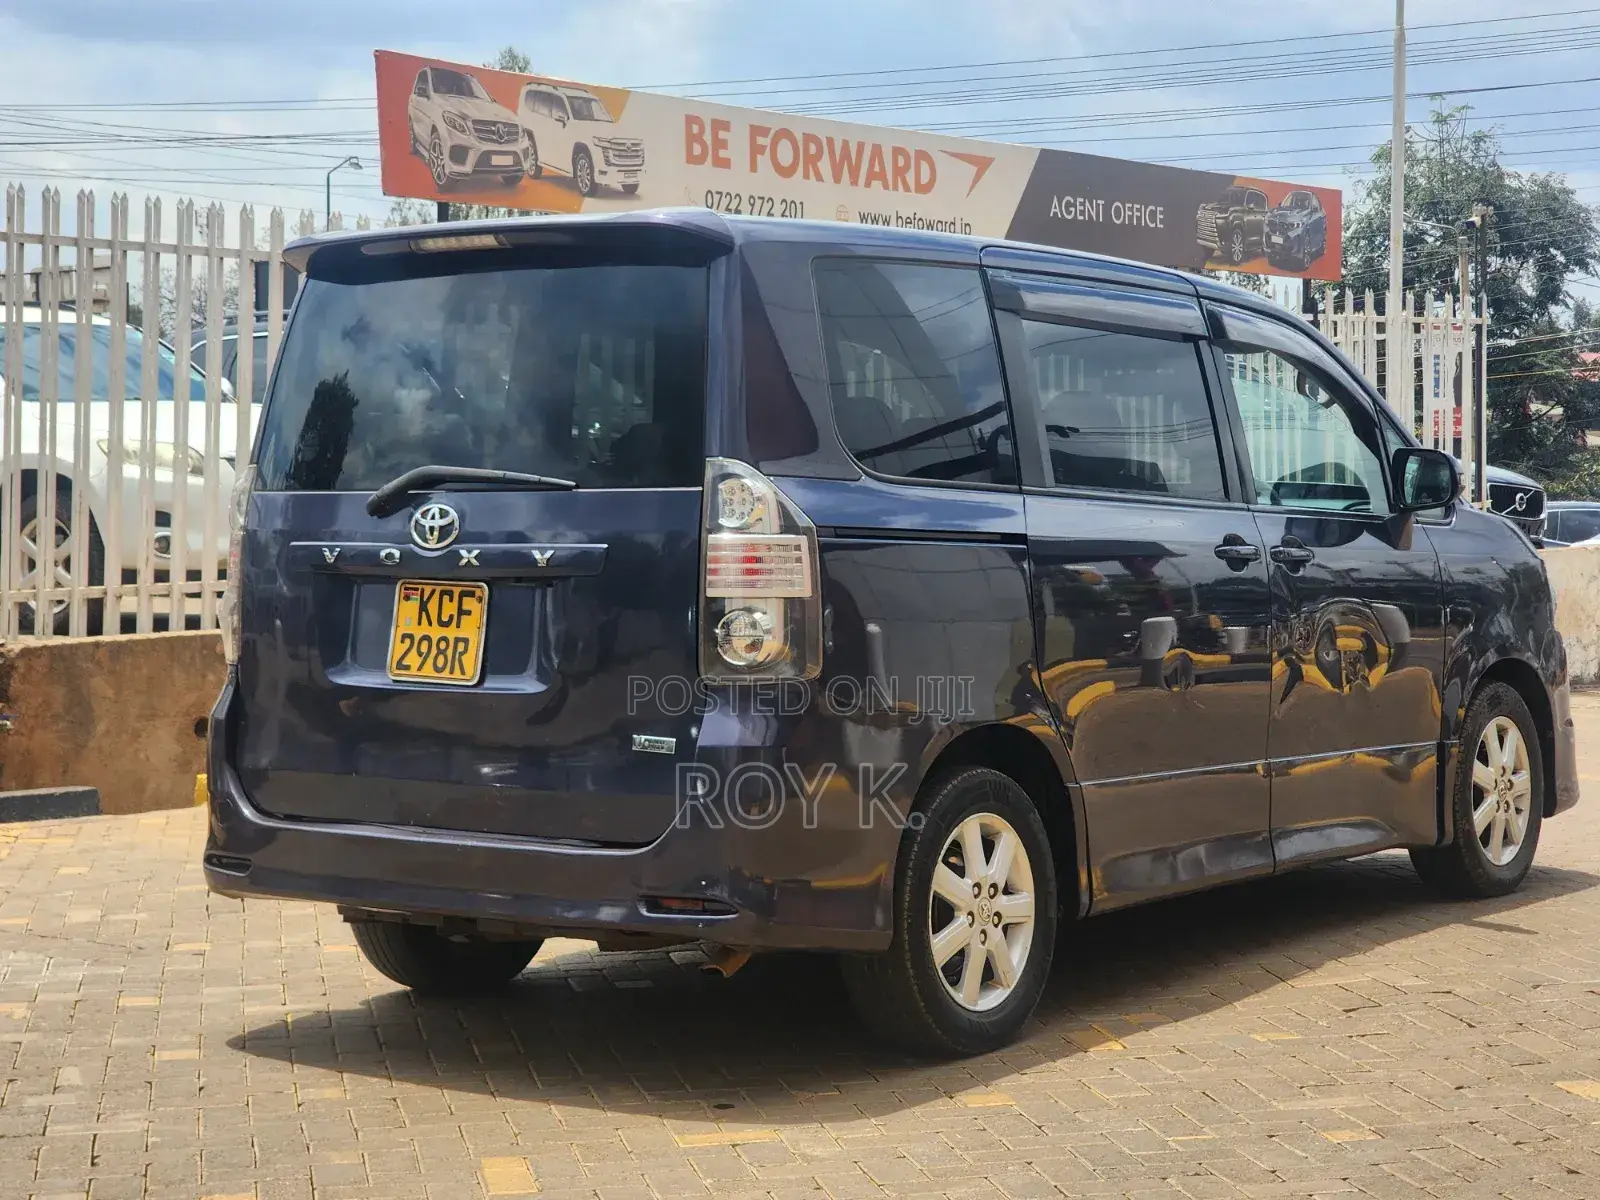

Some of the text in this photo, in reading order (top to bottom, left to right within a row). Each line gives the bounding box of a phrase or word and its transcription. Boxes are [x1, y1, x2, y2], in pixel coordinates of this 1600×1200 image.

[684, 113, 937, 195] BE FORWARD
[705, 189, 804, 219] 0722 972 201
[1049, 194, 1165, 229] AGENT OFFICE
[857, 210, 973, 236] wwwbefoward.jp
[321, 547, 555, 567] VOXY
[417, 587, 476, 629] KCF
[395, 632, 470, 676] 298R
